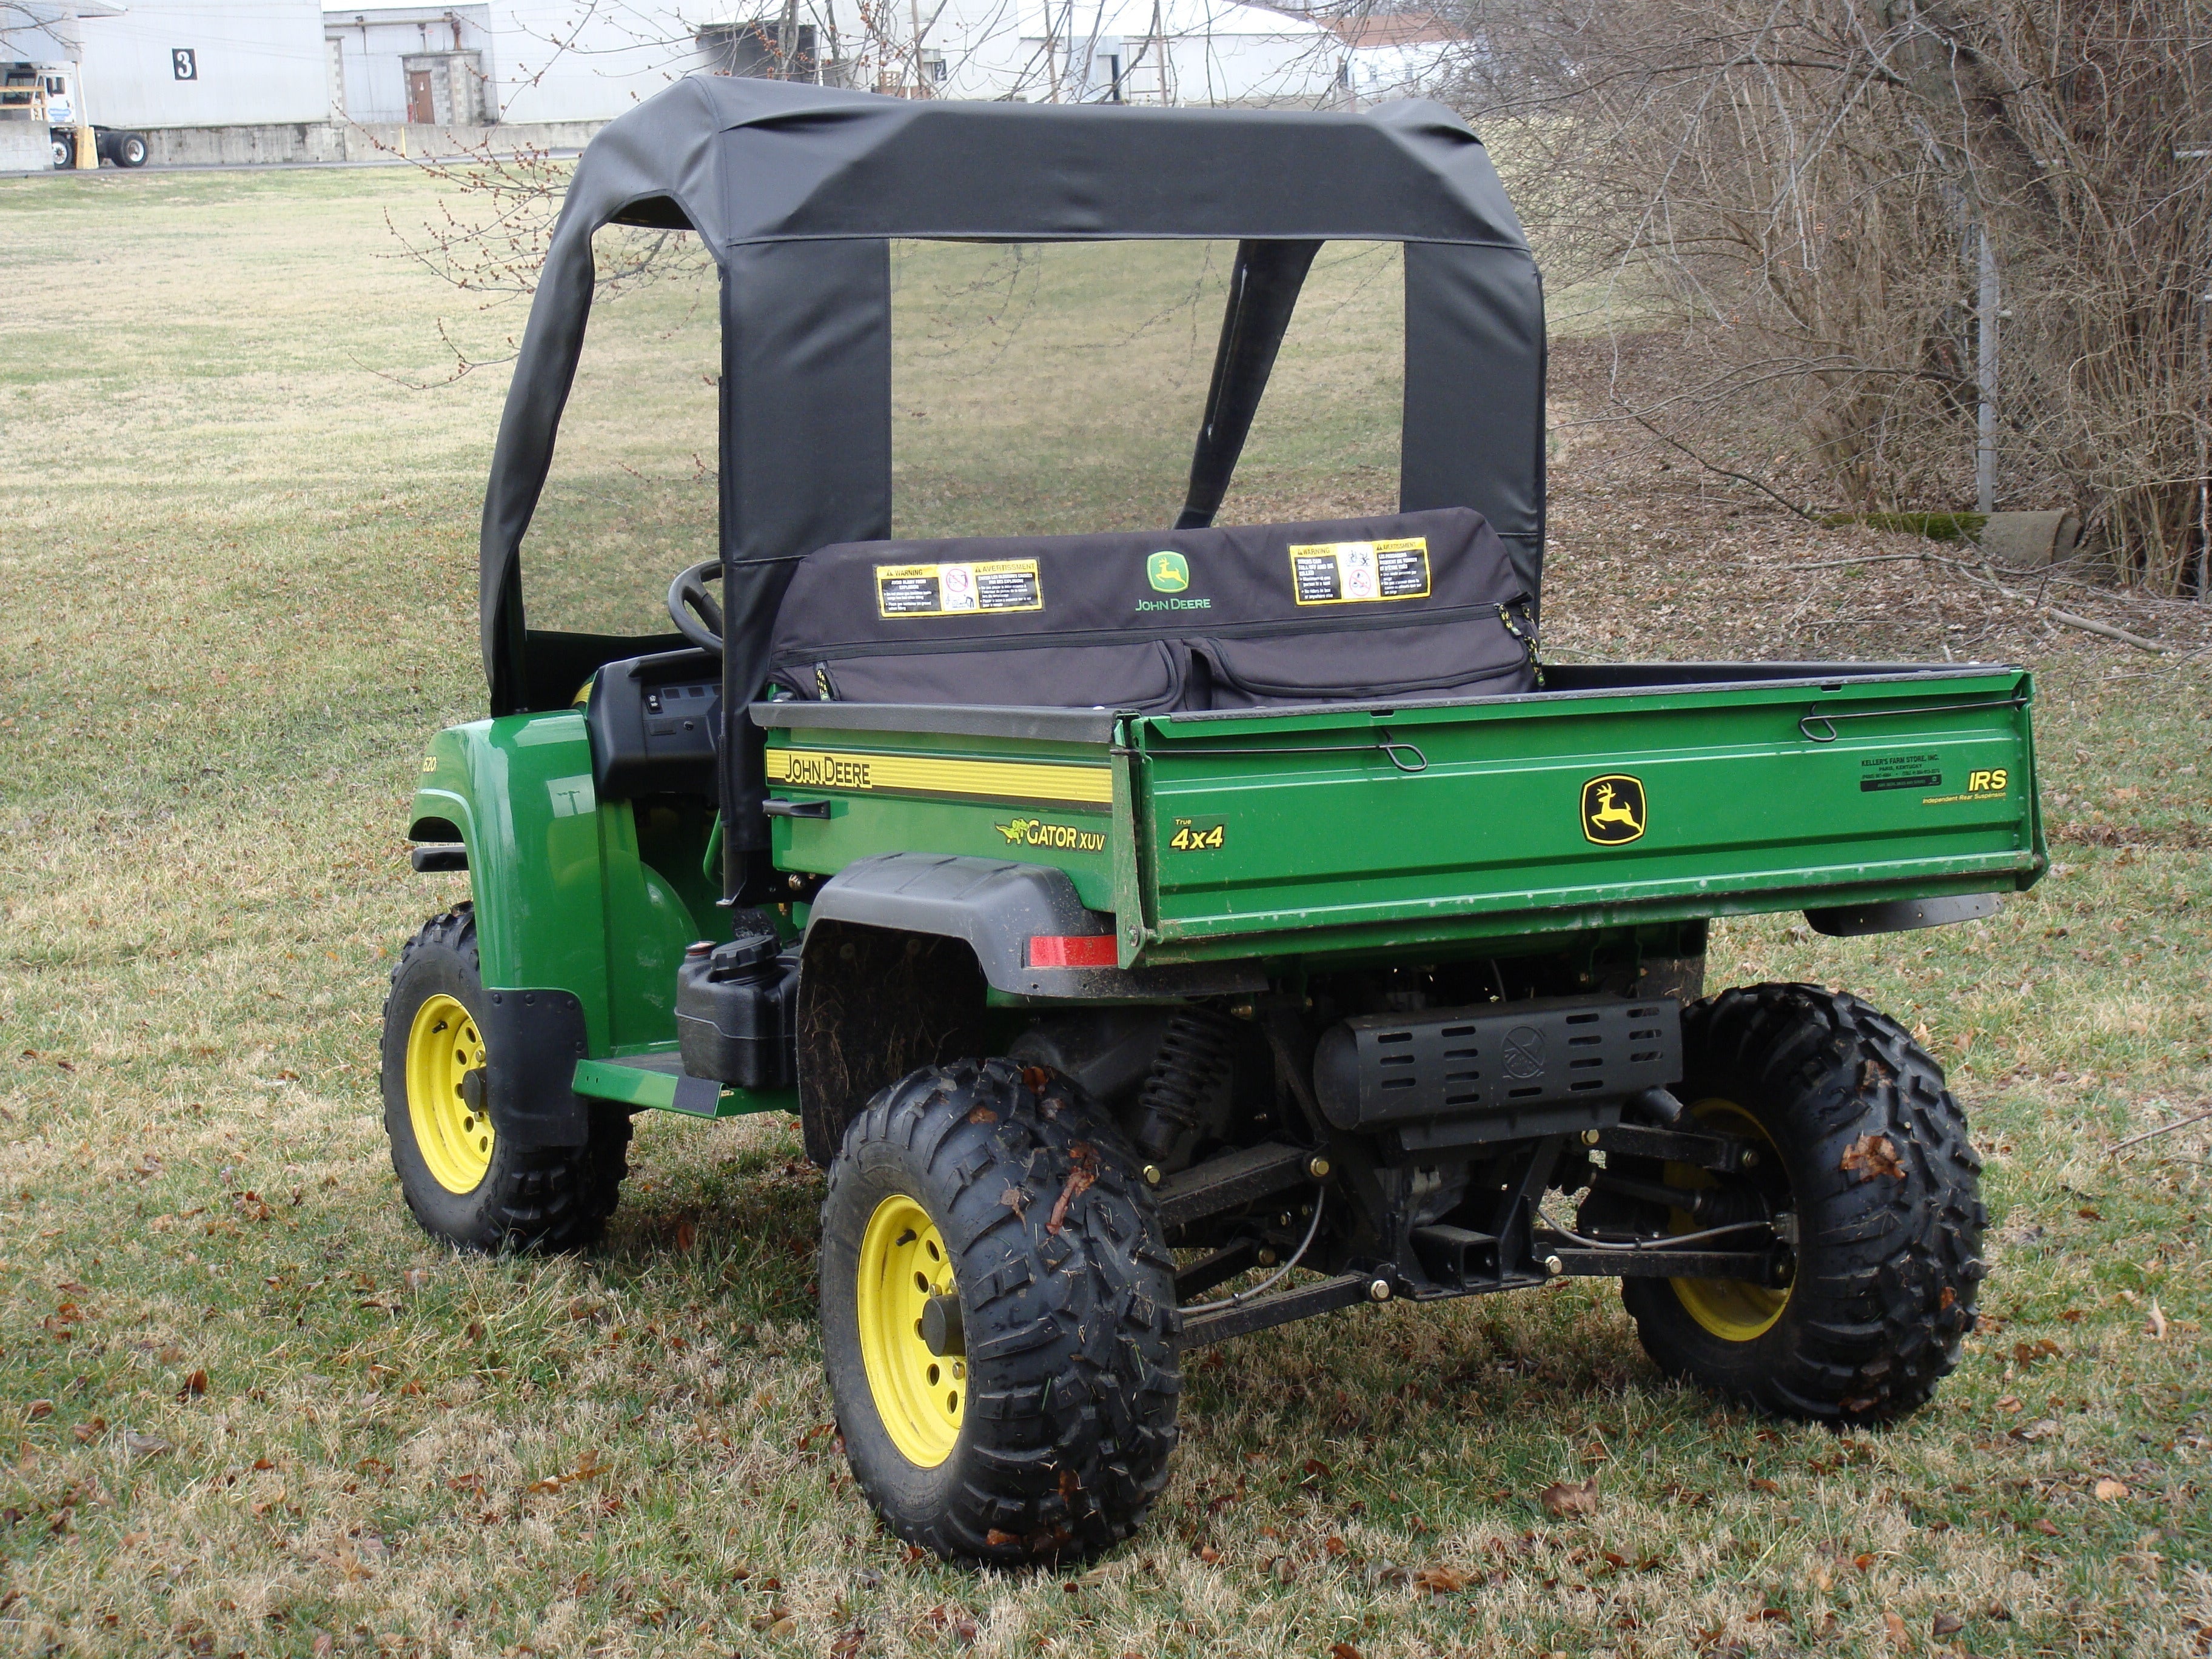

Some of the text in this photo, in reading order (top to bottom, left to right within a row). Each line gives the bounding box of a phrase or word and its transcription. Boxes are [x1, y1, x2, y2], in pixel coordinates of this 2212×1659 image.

[176, 51, 193, 78] 3
[982, 563, 1035, 572] AVERTISSMENT
[1135, 598, 1212, 611] JOHN DEERE
[785, 754, 871, 786] JOHN DEERE
[1862, 758, 1888, 766] KELLER'S
[1968, 769, 2008, 791] IRS
[1922, 795, 1958, 804] Independent
[1027, 819, 1105, 850] GATOR XUV
[1171, 826, 1223, 850] 4x4
